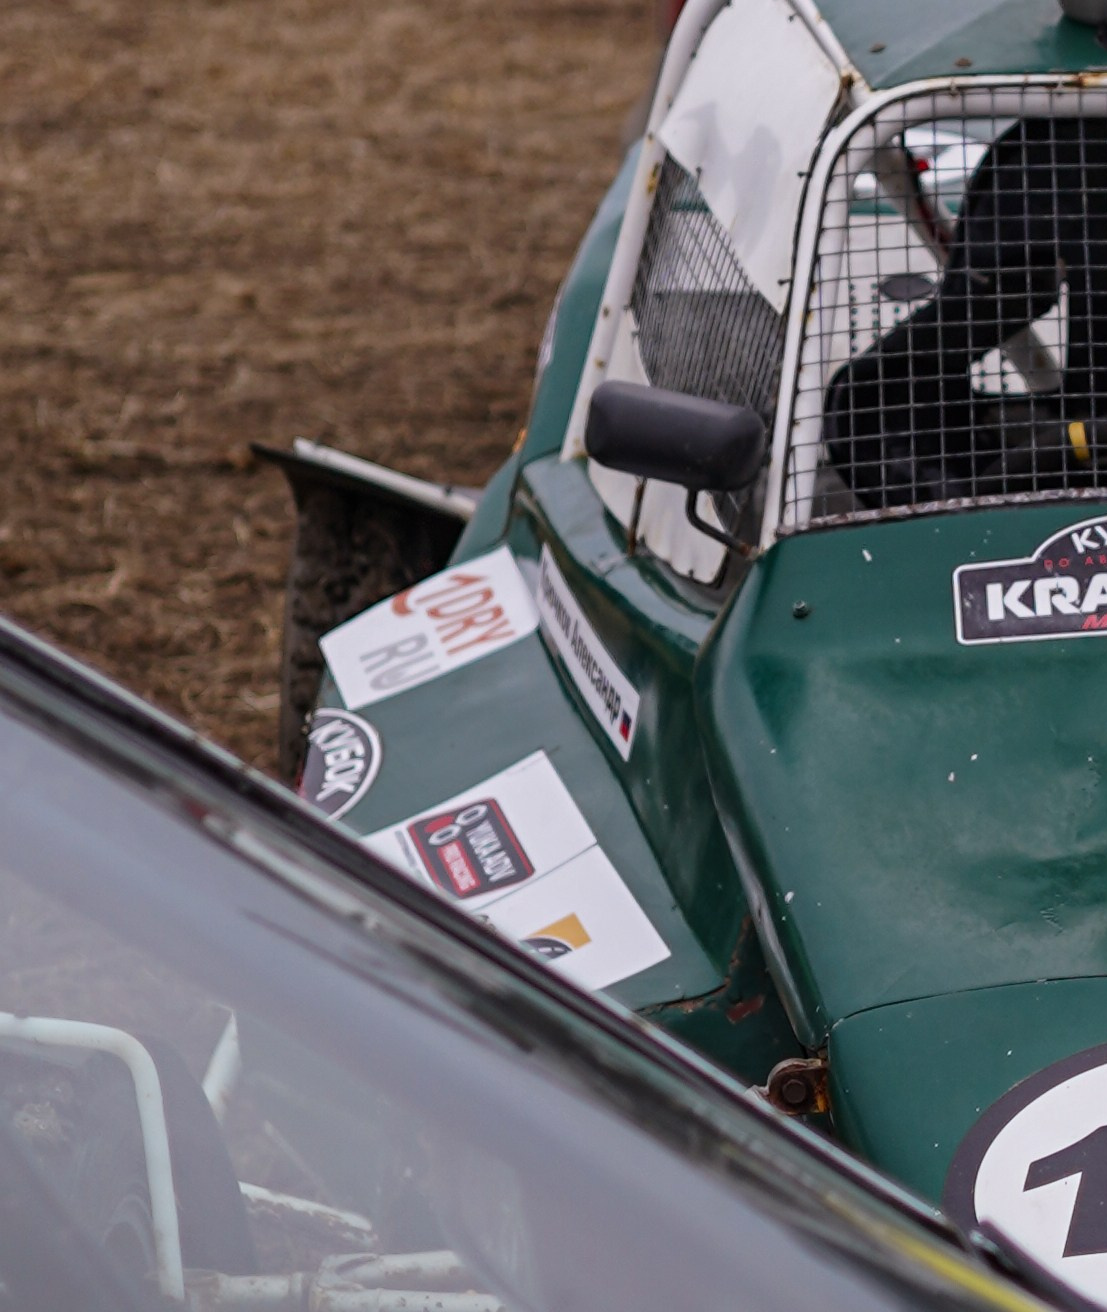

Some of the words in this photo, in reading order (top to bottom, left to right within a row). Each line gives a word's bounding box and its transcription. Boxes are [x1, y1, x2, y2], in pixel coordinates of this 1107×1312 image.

[1044, 557, 1070, 571] ПО
[570, 619, 622, 726] Александр
[309, 719, 368, 802] КУБОК
